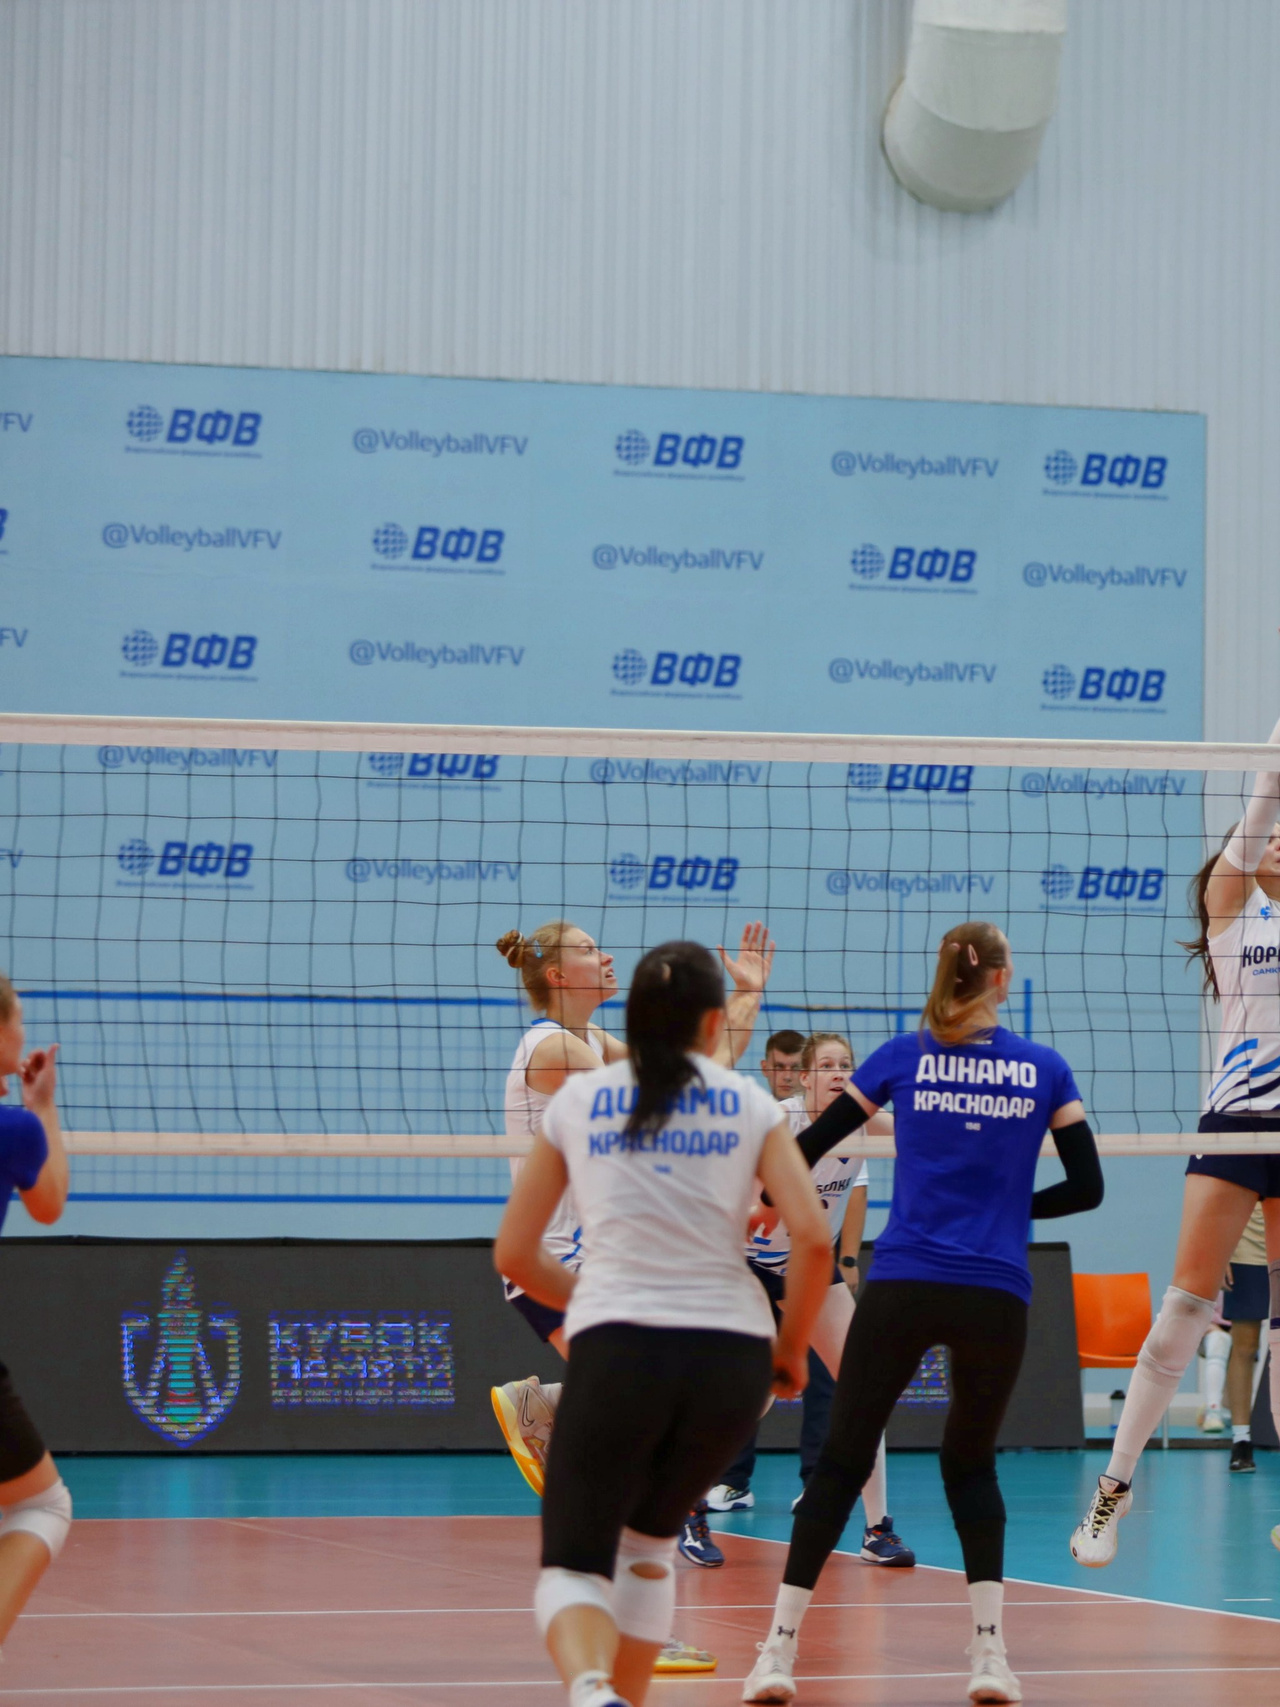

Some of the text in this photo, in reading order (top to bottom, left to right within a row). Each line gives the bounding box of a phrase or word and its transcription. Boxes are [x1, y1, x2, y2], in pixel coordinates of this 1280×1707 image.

[167, 409, 261, 445] ВФВ
[354, 428, 527, 456] @VolleyballVFV
[654, 434, 743, 468] ВФВ
[832, 451, 998, 478] @VolleyballVFV
[1081, 454, 1167, 488] ВФВ
[103, 522, 279, 550] @VolleyballVFV
[412, 527, 503, 562] ВФВ
[593, 543, 763, 572] @VolleyballVFV
[889, 547, 976, 582] ВФВ
[1024, 562, 1186, 589] @VolleyballVFV
[162, 634, 256, 669] ВФВ
[350, 640, 522, 667] @VolleyballVFV
[651, 653, 741, 687] ВФВ
[830, 658, 995, 685] @VolleyballVFV
[1080, 668, 1165, 701] ВФВ
[98, 748, 277, 774] @VolleyballVFV
[592, 761, 759, 786] @VolleyballVFV
[887, 765, 972, 792] ВФВ
[1022, 773, 1184, 796] @VolleyballVFV
[159, 843, 252, 877] ВФВ
[347, 858, 521, 884] @VolleyballVFV
[649, 857, 738, 890] ВФВ
[828, 871, 992, 895] @VolleyballVFV
[1079, 867, 1163, 900] ВФВ
[916, 1054, 1037, 1088] ДИНАМО
[590, 1087, 740, 1121] ДИАМО
[914, 1090, 1036, 1119] КРАСНОДАР
